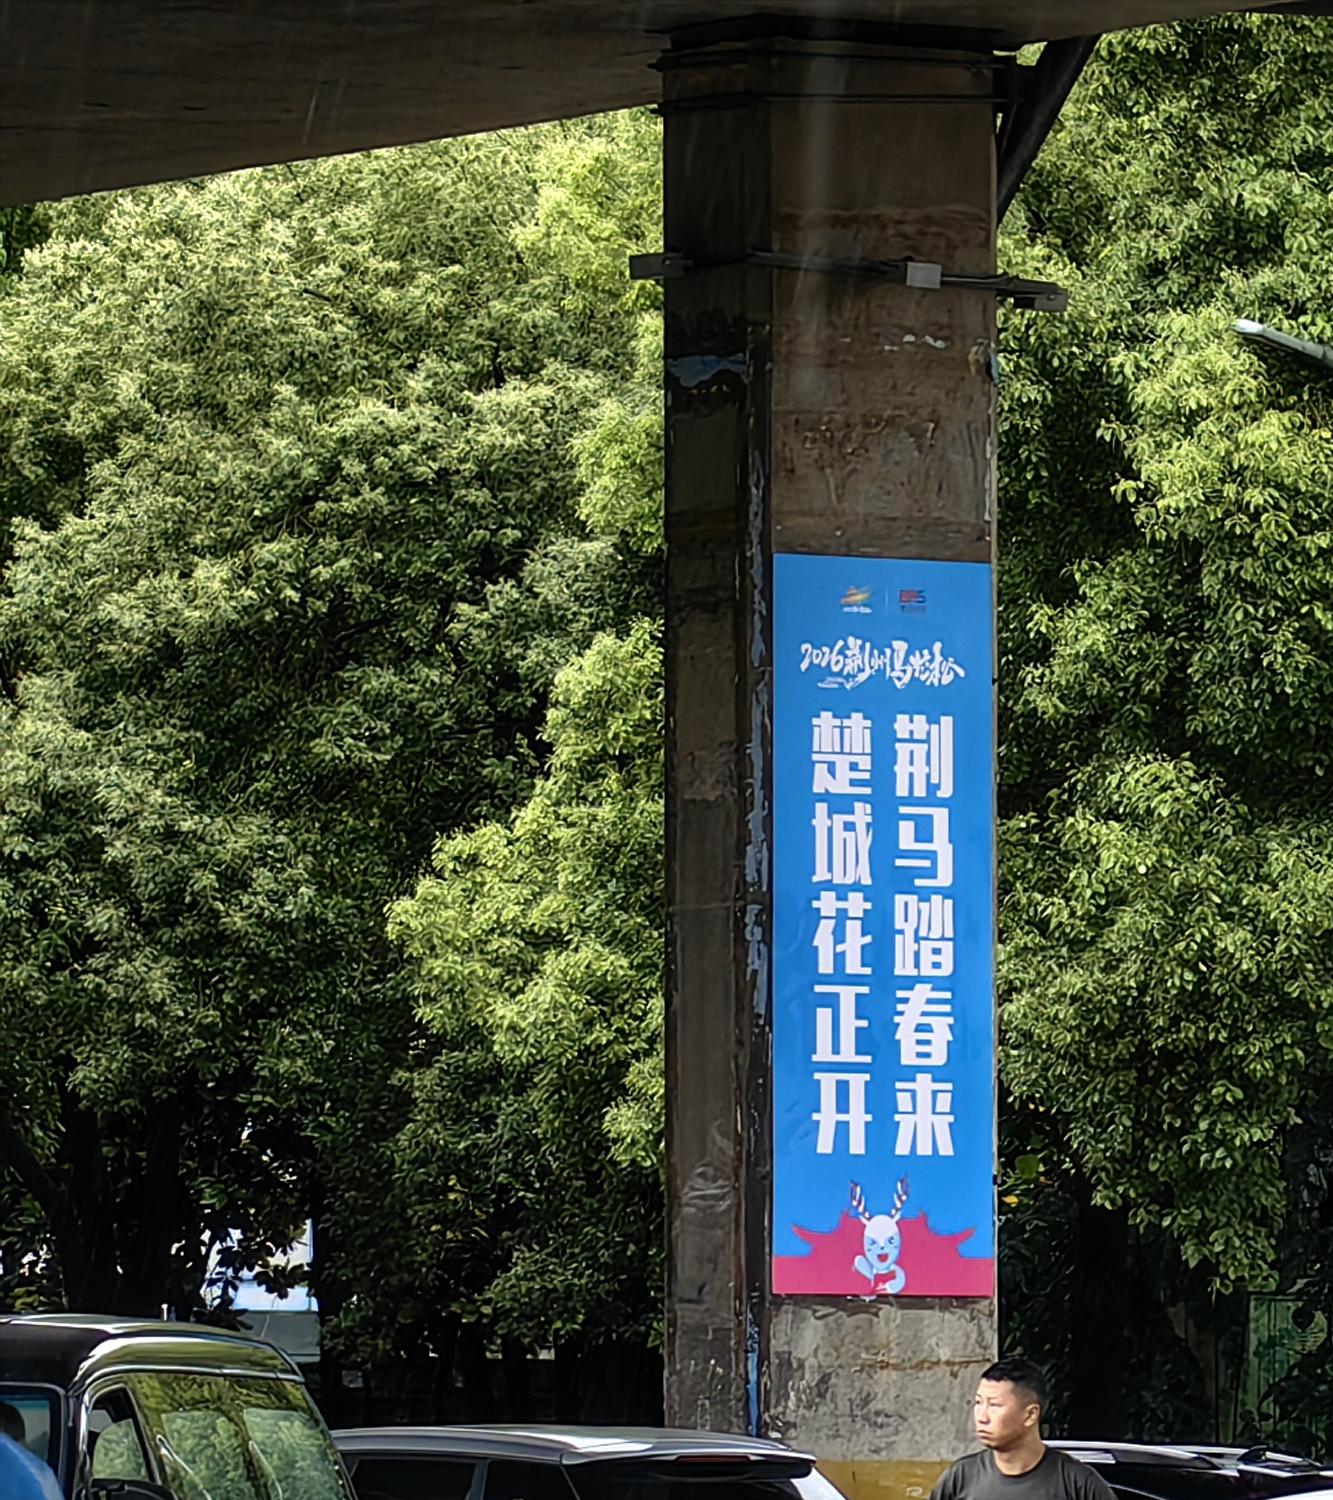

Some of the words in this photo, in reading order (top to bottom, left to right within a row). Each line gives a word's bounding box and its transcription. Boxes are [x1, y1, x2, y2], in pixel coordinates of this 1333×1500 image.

[800, 635, 966, 690] 2026荆州马拉松
[812, 711, 872, 1155] 楚城花正开
[894, 714, 954, 1157] 荆马踏春来
